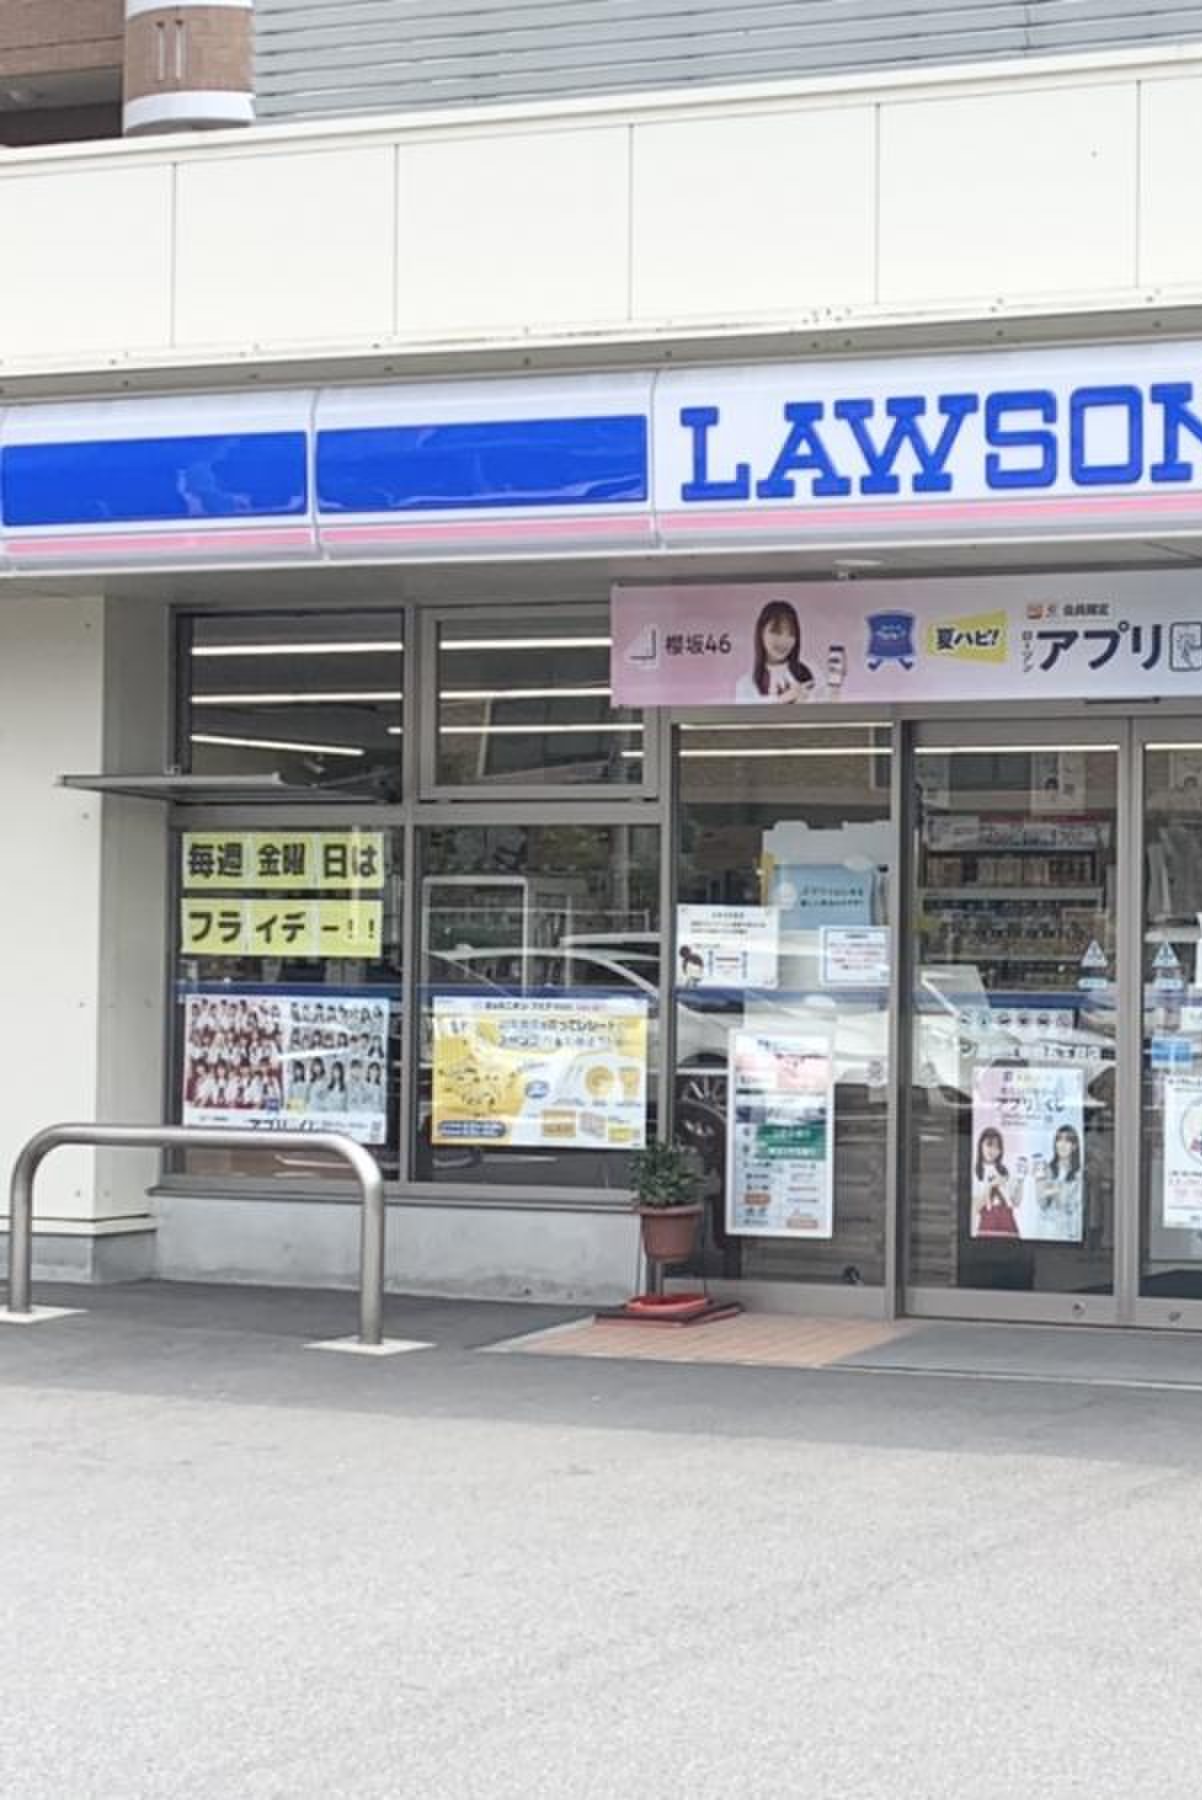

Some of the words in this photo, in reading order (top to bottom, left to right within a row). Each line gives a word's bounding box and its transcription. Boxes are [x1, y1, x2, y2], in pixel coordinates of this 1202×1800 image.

[665, 632, 733, 656] 櫻坂46
[1036, 620, 1163, 671] アプリ
